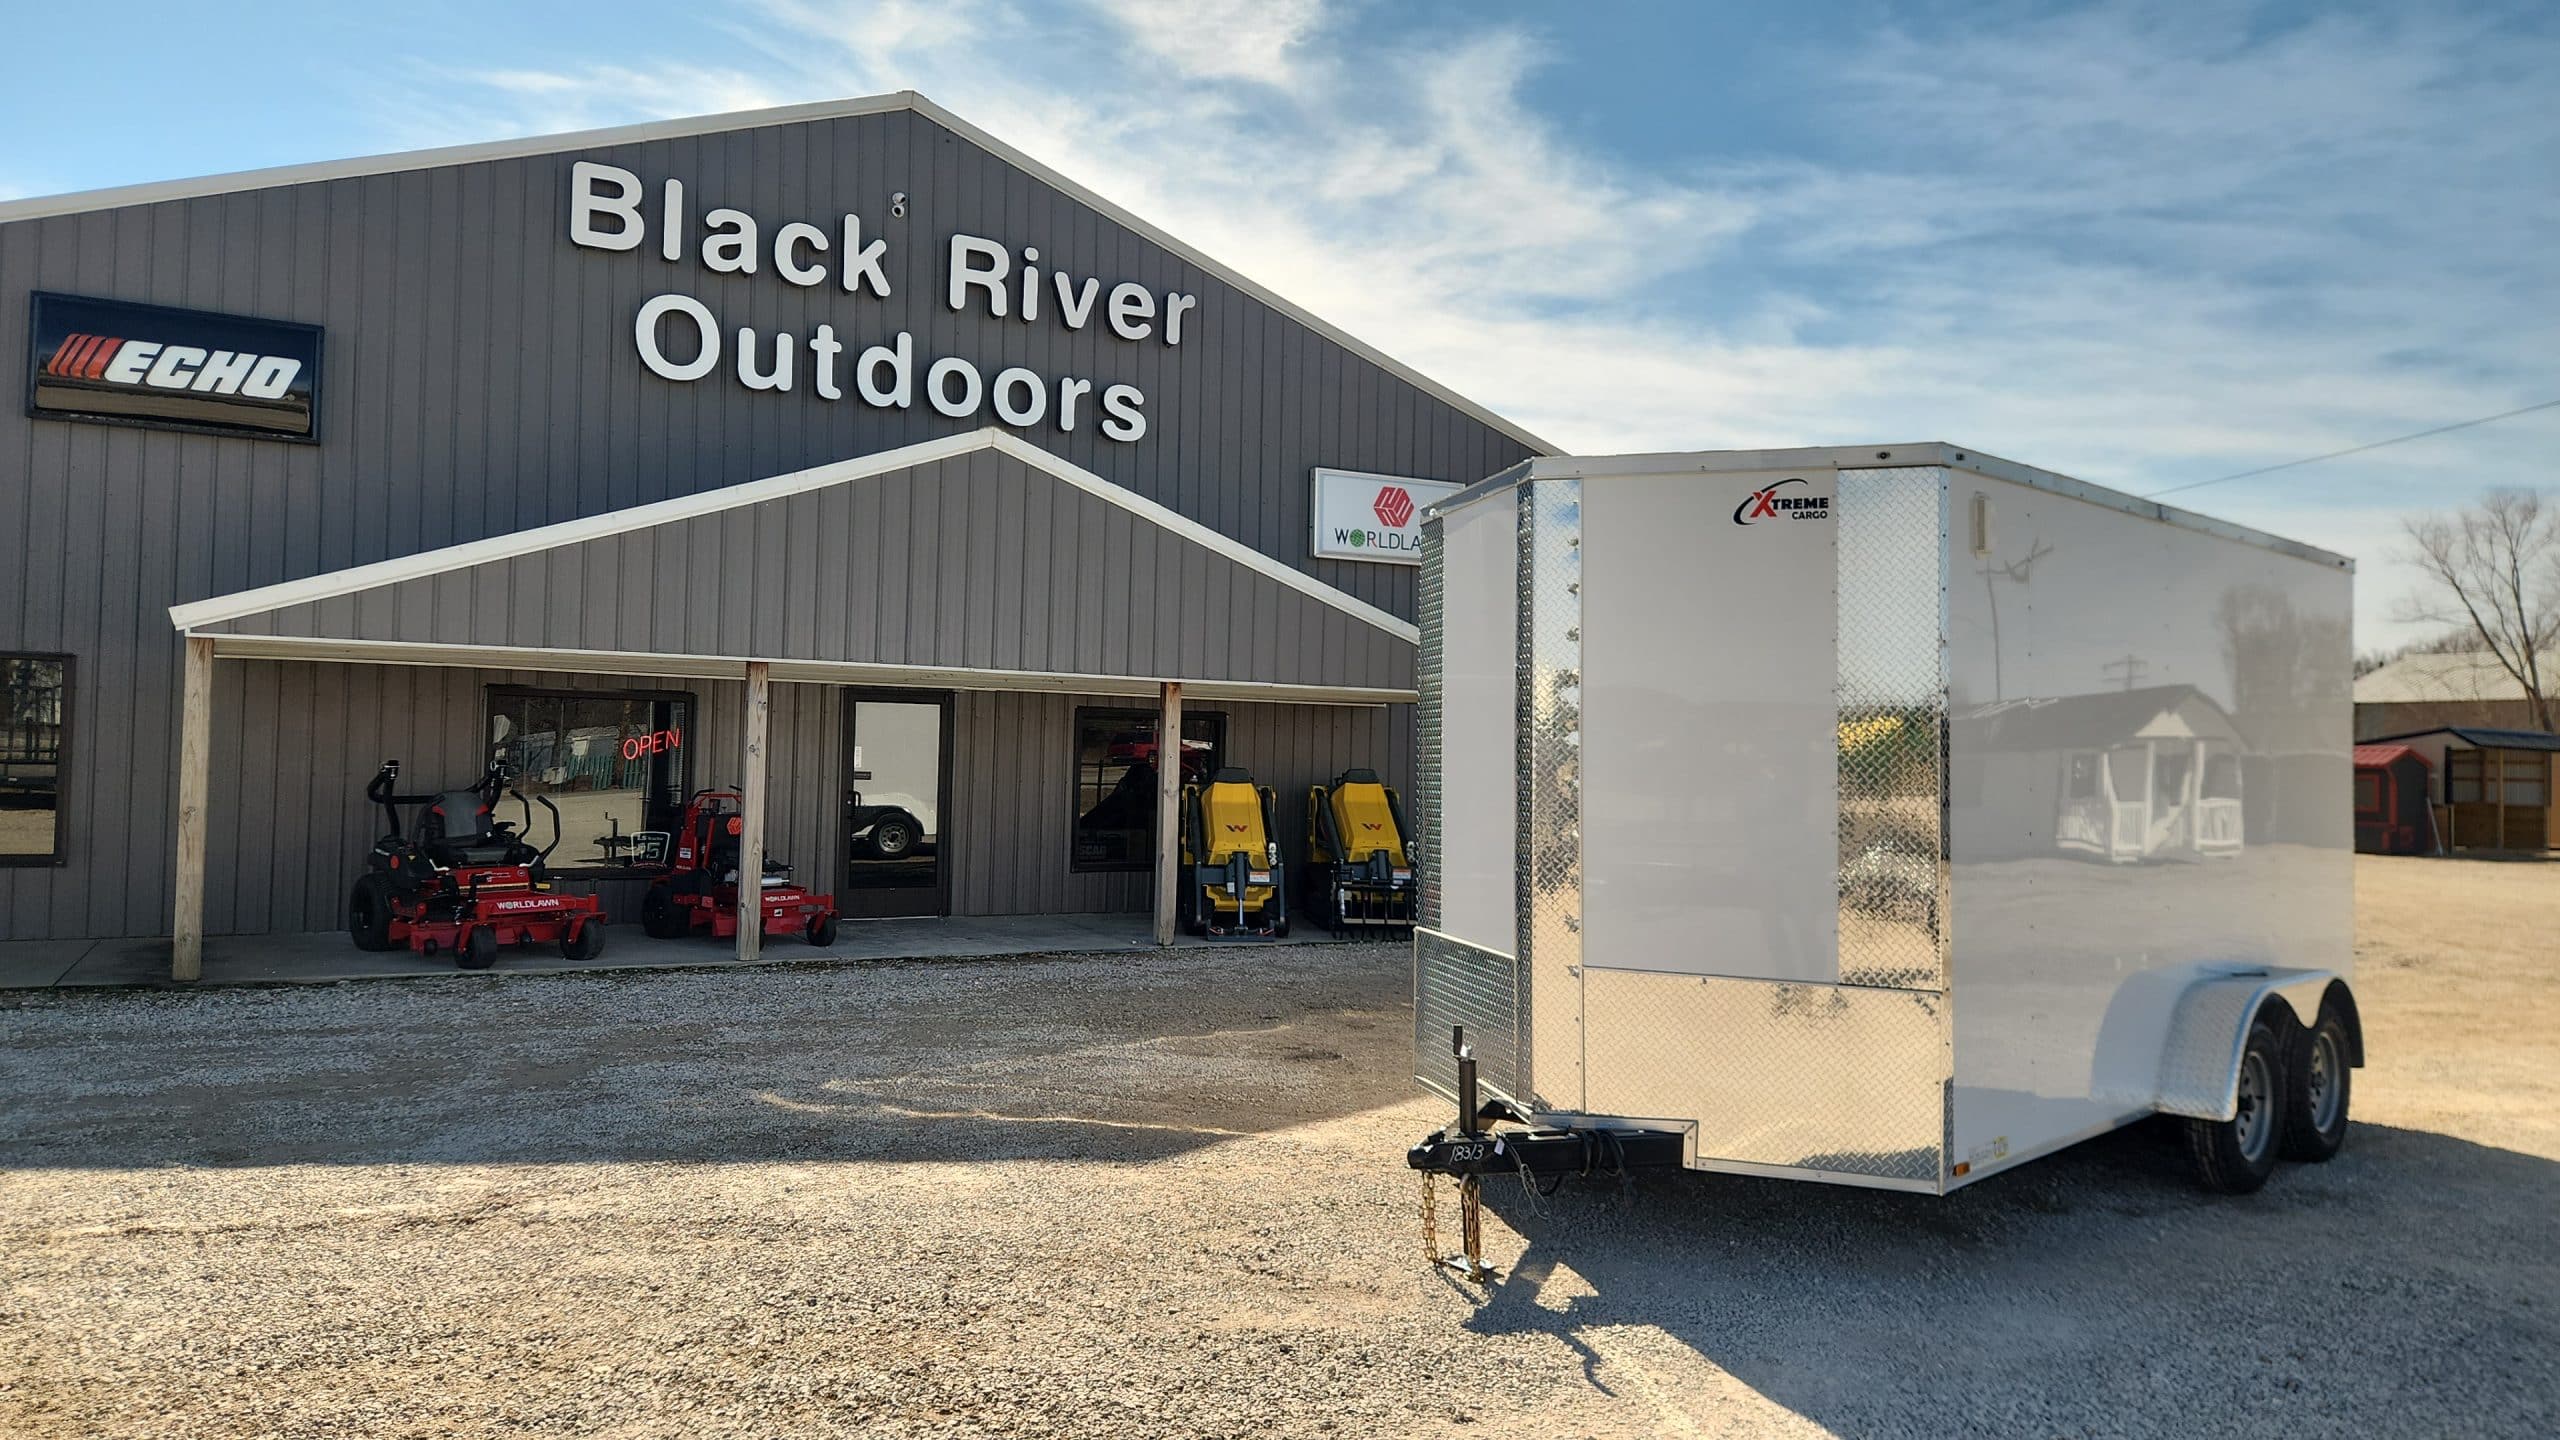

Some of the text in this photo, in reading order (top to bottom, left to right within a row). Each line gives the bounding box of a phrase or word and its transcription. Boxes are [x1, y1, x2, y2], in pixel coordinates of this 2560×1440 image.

[570, 160, 1196, 346] Black River
[104, 339, 302, 400] ECHO
[635, 293, 1148, 442] Outdoors
[1750, 490, 1829, 518] XTREME
[1791, 510, 1828, 520] CARGO
[1334, 527, 1421, 551] WORLDLA
[623, 728, 680, 760] OPEN
[496, 898, 560, 911] WORLDLAWN
